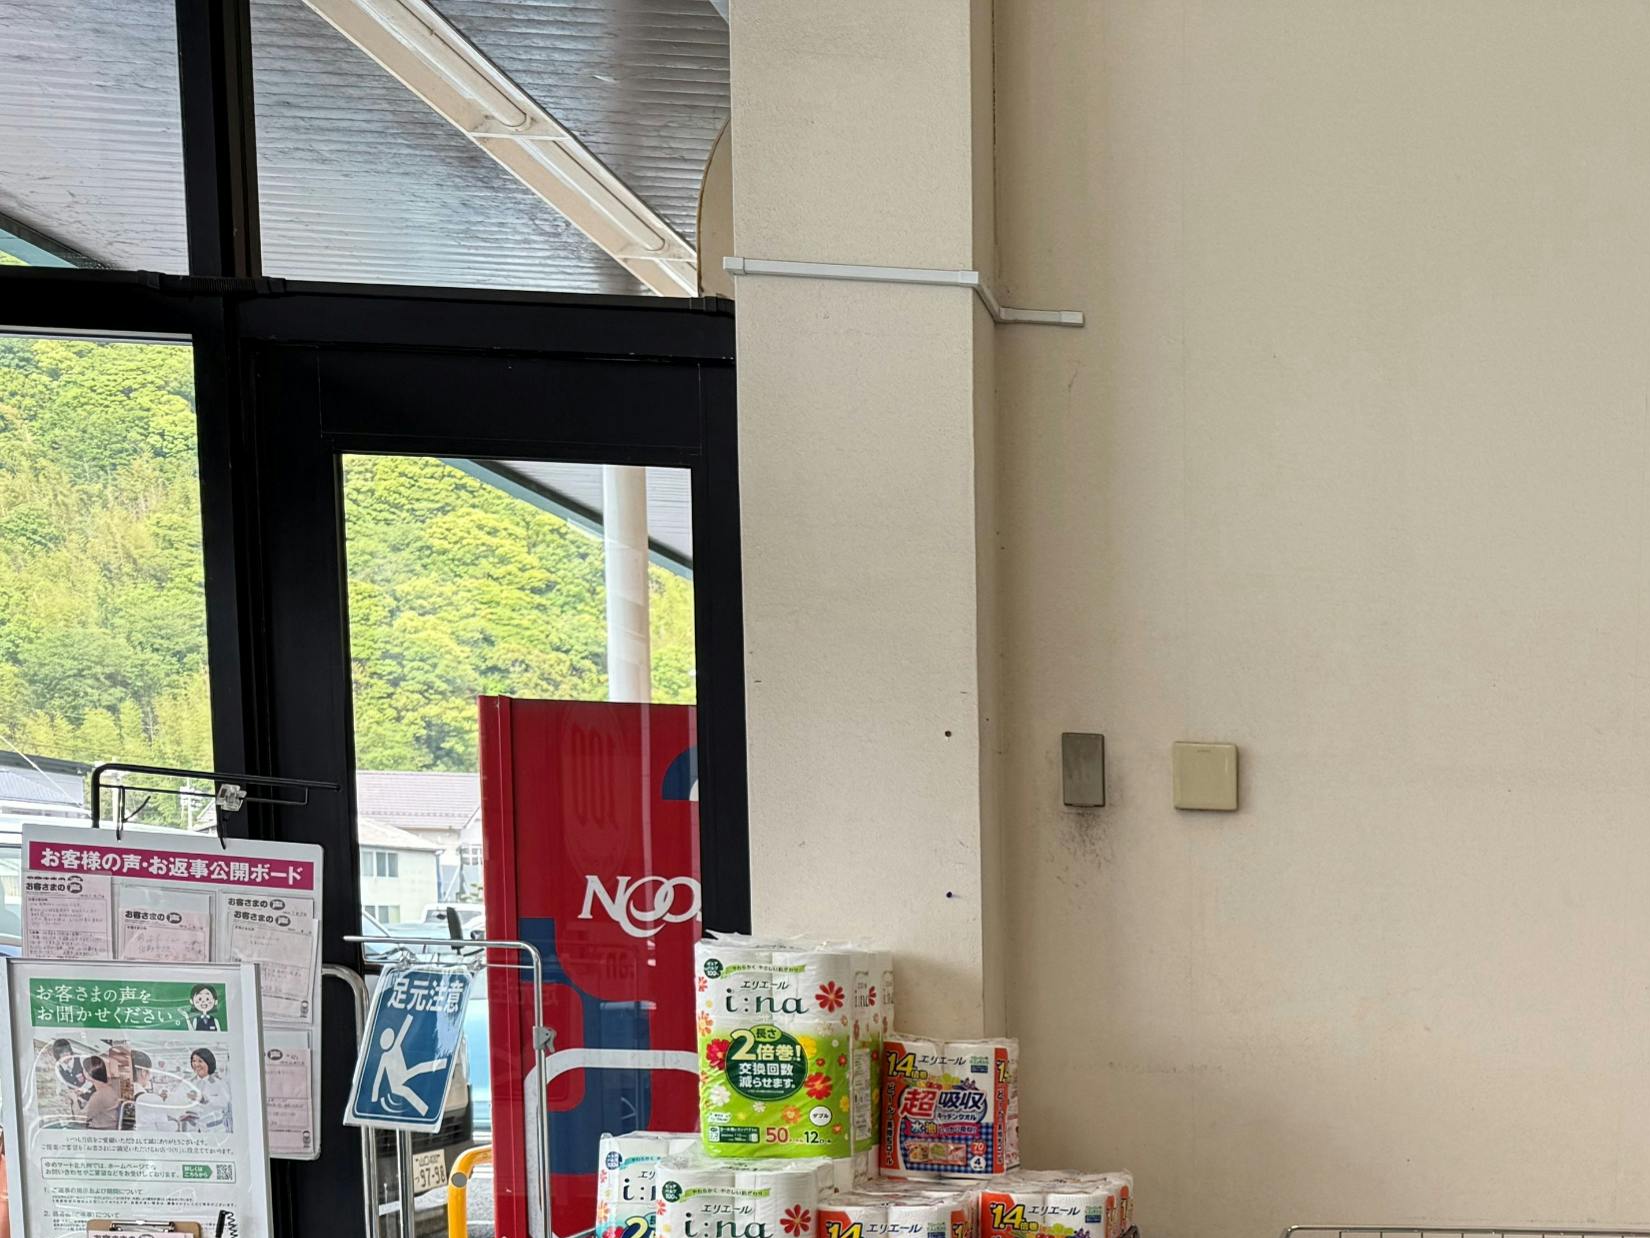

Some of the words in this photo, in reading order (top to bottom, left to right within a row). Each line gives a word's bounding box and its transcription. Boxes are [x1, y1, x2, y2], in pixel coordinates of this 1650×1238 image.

[40, 847, 304, 886] お客様の声・お返事公開ボード
[740, 980, 791, 991] エリエール
[36, 985, 152, 1003] お客さまの声を
[387, 977, 464, 1013] 足元注意
[725, 988, 809, 1014] i:na
[37, 1005, 182, 1026] お聞かせください。
[755, 1028, 777, 1039] 長さ
[918, 1055, 966, 1066] エリエール
[739, 1062, 794, 1076] 交換回数
[739, 1076, 796, 1089] 減らせます。
[900, 1088, 986, 1118] 超吸収
[765, 1127, 789, 1143] 50
[804, 1131, 819, 1144] 12
[420, 1165, 446, 1188] 97-98
[701, 1203, 753, 1215] エリエール
[1028, 1206, 1081, 1216] エリエール
[866, 1223, 923, 1234] エリエール
